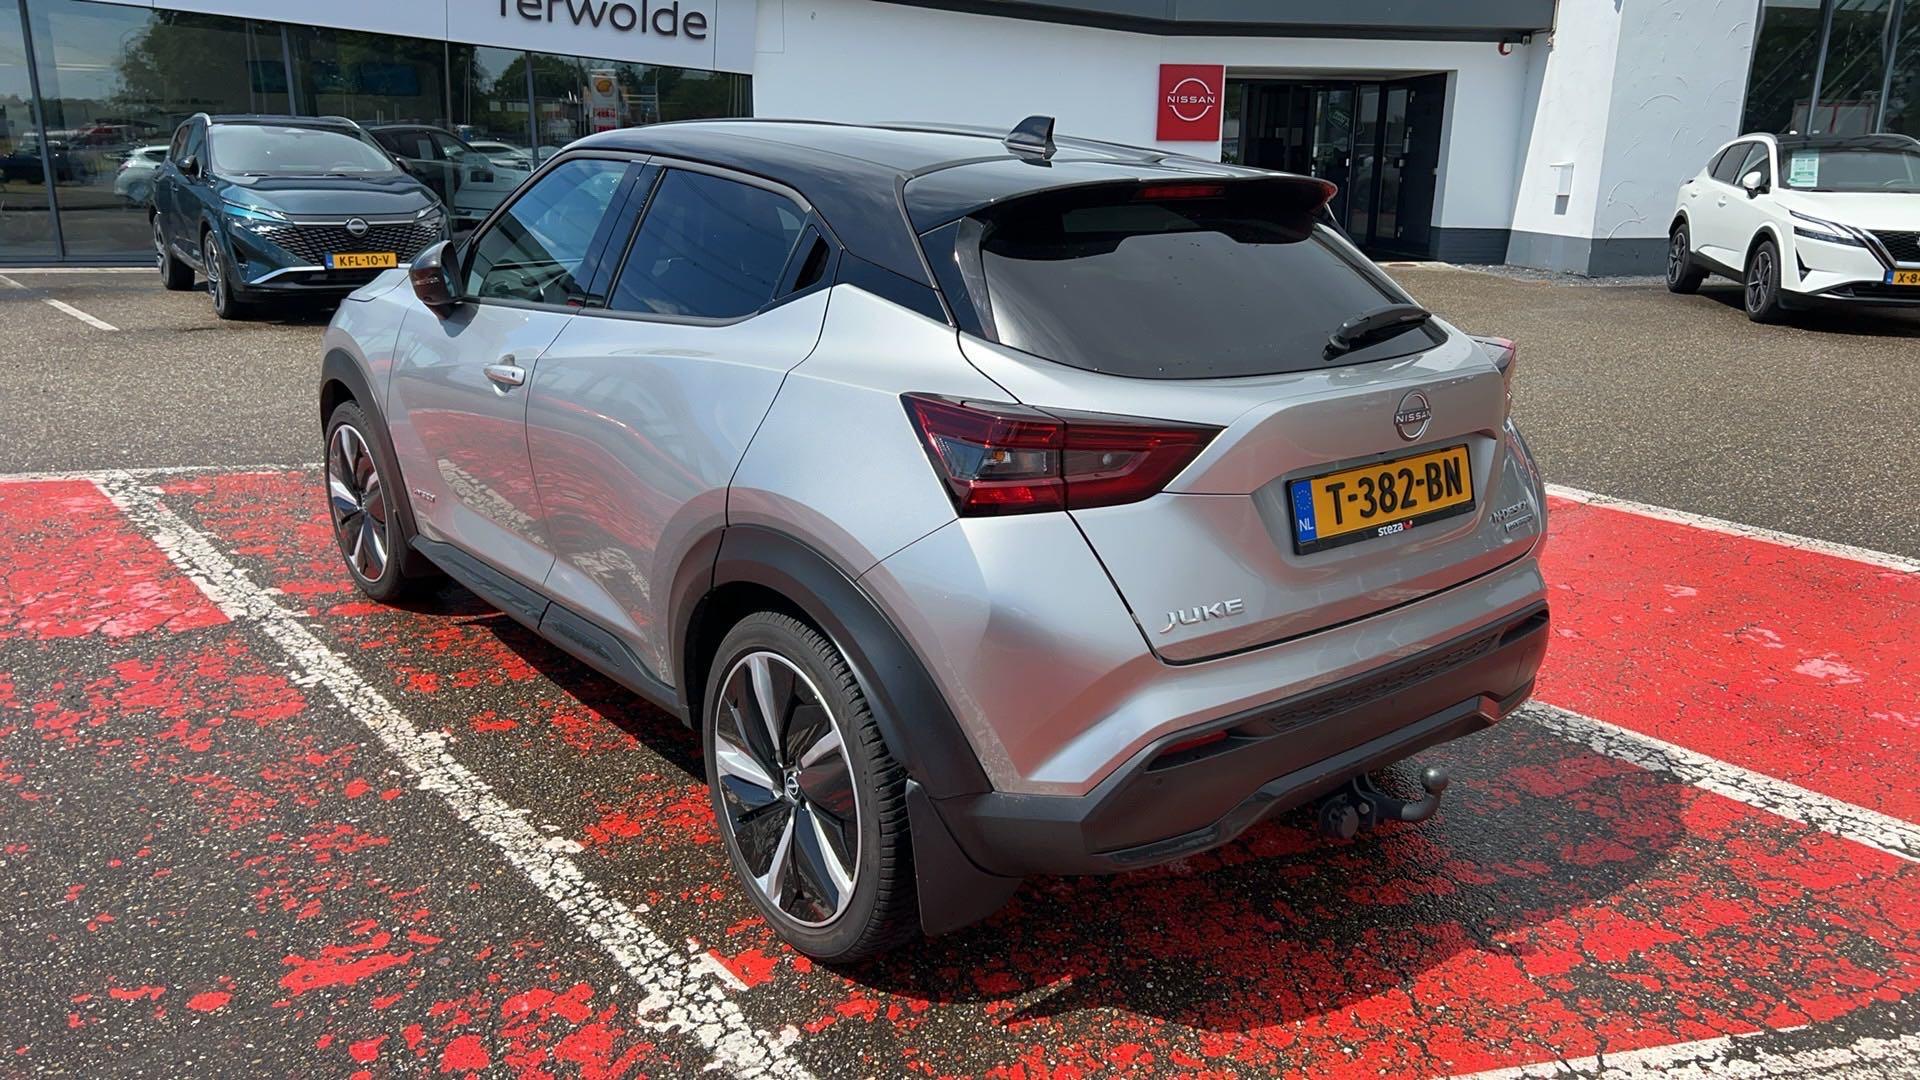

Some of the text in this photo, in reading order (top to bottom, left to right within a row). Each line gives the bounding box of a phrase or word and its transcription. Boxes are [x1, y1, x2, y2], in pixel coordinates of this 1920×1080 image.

[1167, 95, 1216, 104] NISSAN
[339, 254, 390, 267] KFL-10-V
[1897, 272, 1920, 284] X-8
[1395, 410, 1431, 423] NISSAN
[1325, 456, 1463, 526] T-382-BN
[1299, 518, 1314, 532] NL
[1377, 521, 1404, 537] steza
[1159, 598, 1245, 635] JUKE
